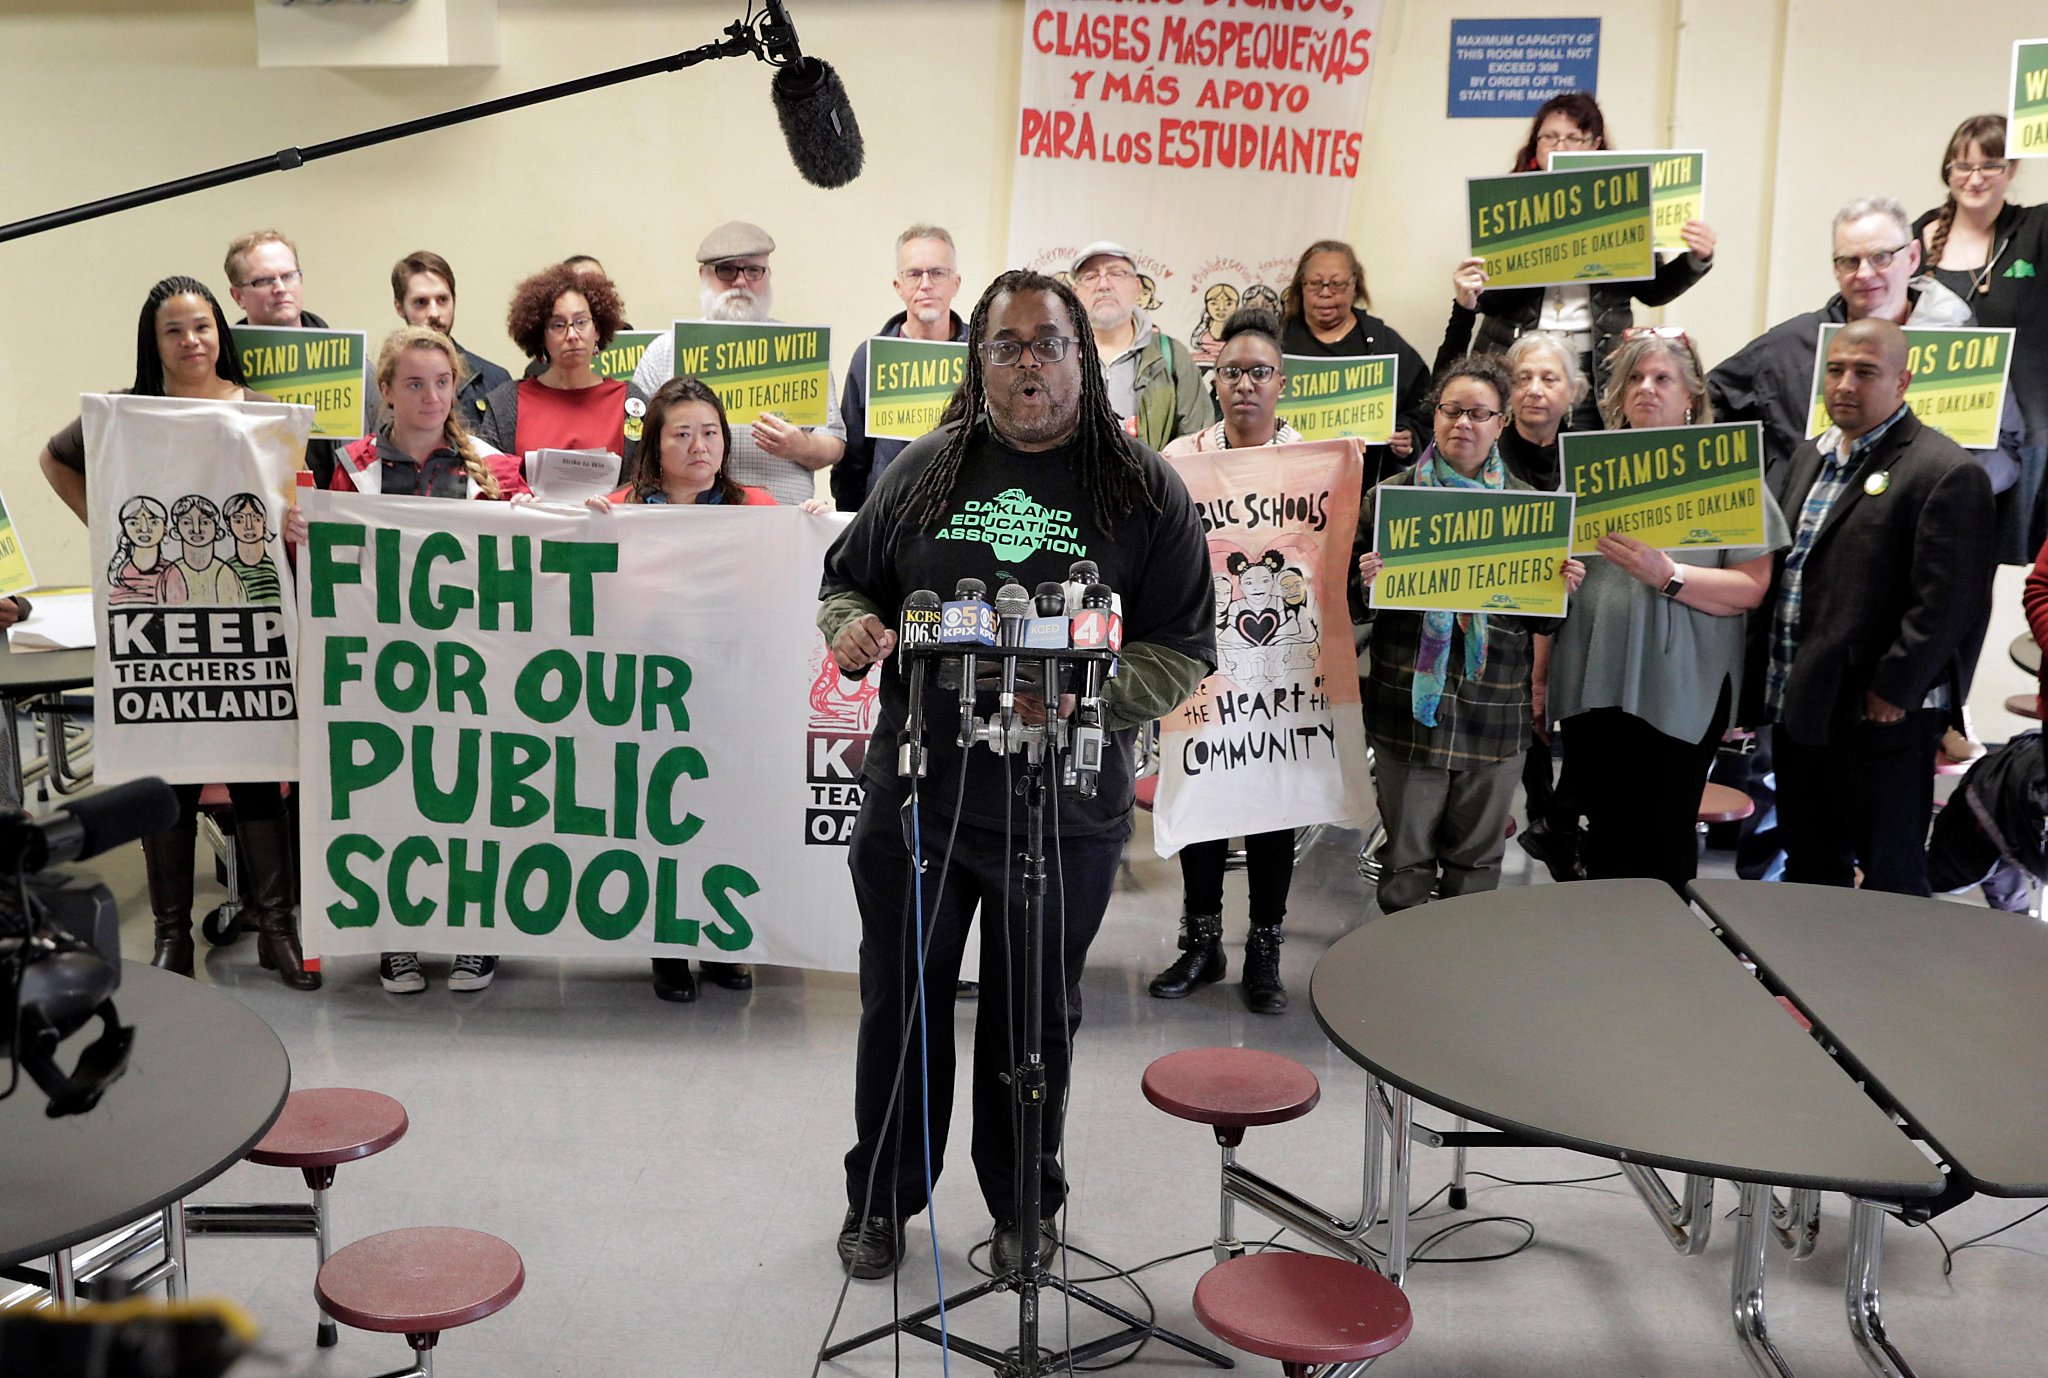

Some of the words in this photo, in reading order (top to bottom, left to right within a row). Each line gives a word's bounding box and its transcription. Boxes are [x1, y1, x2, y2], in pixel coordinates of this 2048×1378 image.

[1033, 10, 1150, 63] CLASES
[1456, 35, 1514, 46] MAXIMUM
[1516, 34, 1575, 46] CAPACITY
[1577, 34, 1595, 45] OF
[1457, 49, 1484, 60] THIS
[1486, 48, 1524, 60] ROOM
[1526, 48, 1564, 59] SHALL
[1567, 48, 1592, 59] NOT
[1488, 62, 1536, 73] EXCEED
[1070, 70, 1094, 99] Y
[1101, 66, 1179, 106] MÁS
[1196, 79, 1309, 113] APOYO
[1459, 90, 1496, 101] STATE
[1498, 89, 1525, 100] FIRE
[1470, 76, 1487, 87] BY
[1488, 76, 1530, 87] ORDER
[1532, 76, 1550, 87] OF
[1552, 75, 1576, 86] THE
[1020, 108, 1095, 161] PARA
[1103, 132, 1152, 164] LOS
[1159, 117, 1362, 178] ESTUDIANTES
[1651, 156, 1692, 189] WITH
[1478, 184, 1582, 238] ESTAMOS
[1594, 171, 1639, 210] CON
[1655, 202, 1692, 227] HERS
[1506, 244, 1568, 273] MAESTROS
[1573, 240, 1588, 258] DE
[1592, 224, 1645, 253] OAKLAND
[243, 344, 299, 378] STAND
[305, 337, 350, 370] WITH
[682, 346, 709, 374] WE
[716, 337, 768, 370] STAND
[774, 331, 817, 363] WITH
[1947, 335, 1999, 372] CON
[877, 357, 963, 391] ESTAMOS
[1292, 370, 1339, 397] STAND
[1345, 361, 1384, 391] WITH
[749, 379, 818, 407] TEACHERS
[1937, 391, 1995, 415] OAKLAND
[876, 410, 893, 426] LOS
[897, 406, 947, 425] MAESTRO
[1321, 401, 1384, 428] TEACHERS
[1574, 443, 1686, 498] ESTAMOS
[1698, 429, 1747, 471] CON
[950, 514, 1079, 539] EDUCATION
[964, 500, 1072, 523] OAKLAND
[1196, 499, 1240, 534] BLIC
[1244, 490, 1329, 532] SCHOOLS
[1388, 516, 1422, 550] WE
[1429, 508, 1494, 546] STAND
[1502, 500, 1555, 537] WITH
[1577, 520, 1600, 543] LOS
[1605, 506, 1672, 535] MAESTROS
[1677, 501, 1693, 521] DE
[1698, 488, 1755, 517] OAKLAND
[935, 528, 1087, 557] ASSOCIATION
[307, 521, 618, 636] FIGHT
[1386, 567, 1460, 599] OAKLAND
[1468, 557, 1554, 590] TEACHERS
[113, 612, 285, 655] KEEP
[905, 610, 941, 623] KCBS
[943, 627, 977, 637] KPIX
[962, 606, 978, 627] 5
[1074, 613, 1100, 644] 4
[115, 662, 256, 682] TEACHERS
[266, 660, 291, 680] IN
[323, 636, 488, 715] FOR
[514, 649, 693, 732] OUR
[118, 689, 294, 720] OAKLAND
[1183, 718, 1336, 776] COMMUNITY
[328, 720, 709, 846] PUBLIC
[325, 833, 760, 951] SCHOOLS
